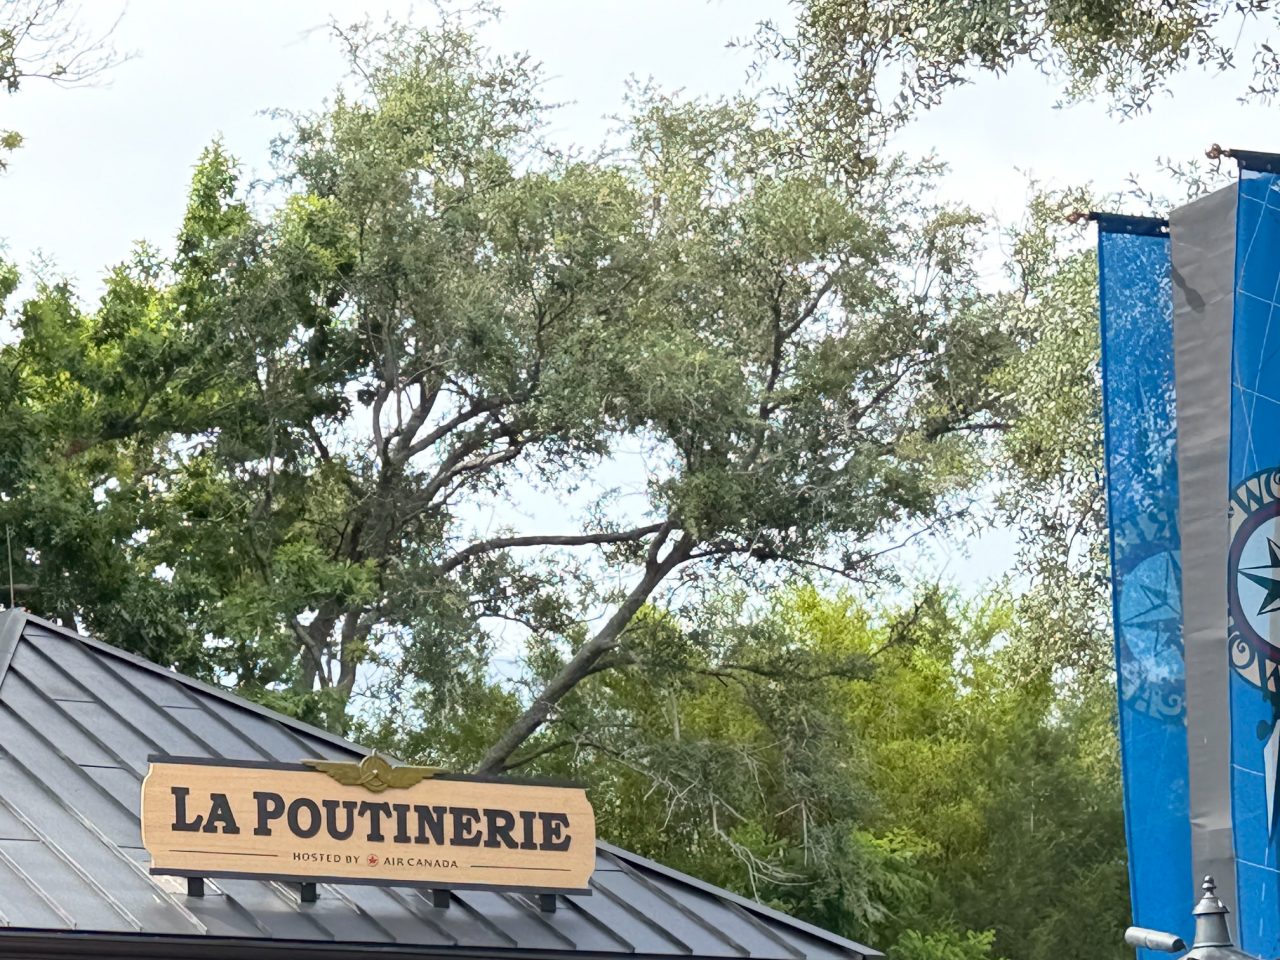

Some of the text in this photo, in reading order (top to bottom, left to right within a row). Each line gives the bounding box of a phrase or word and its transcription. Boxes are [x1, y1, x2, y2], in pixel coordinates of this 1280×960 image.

[171, 786, 572, 852] LA POUTINERIE
[293, 852, 459, 868] HOSTED BY AIR CANADA
